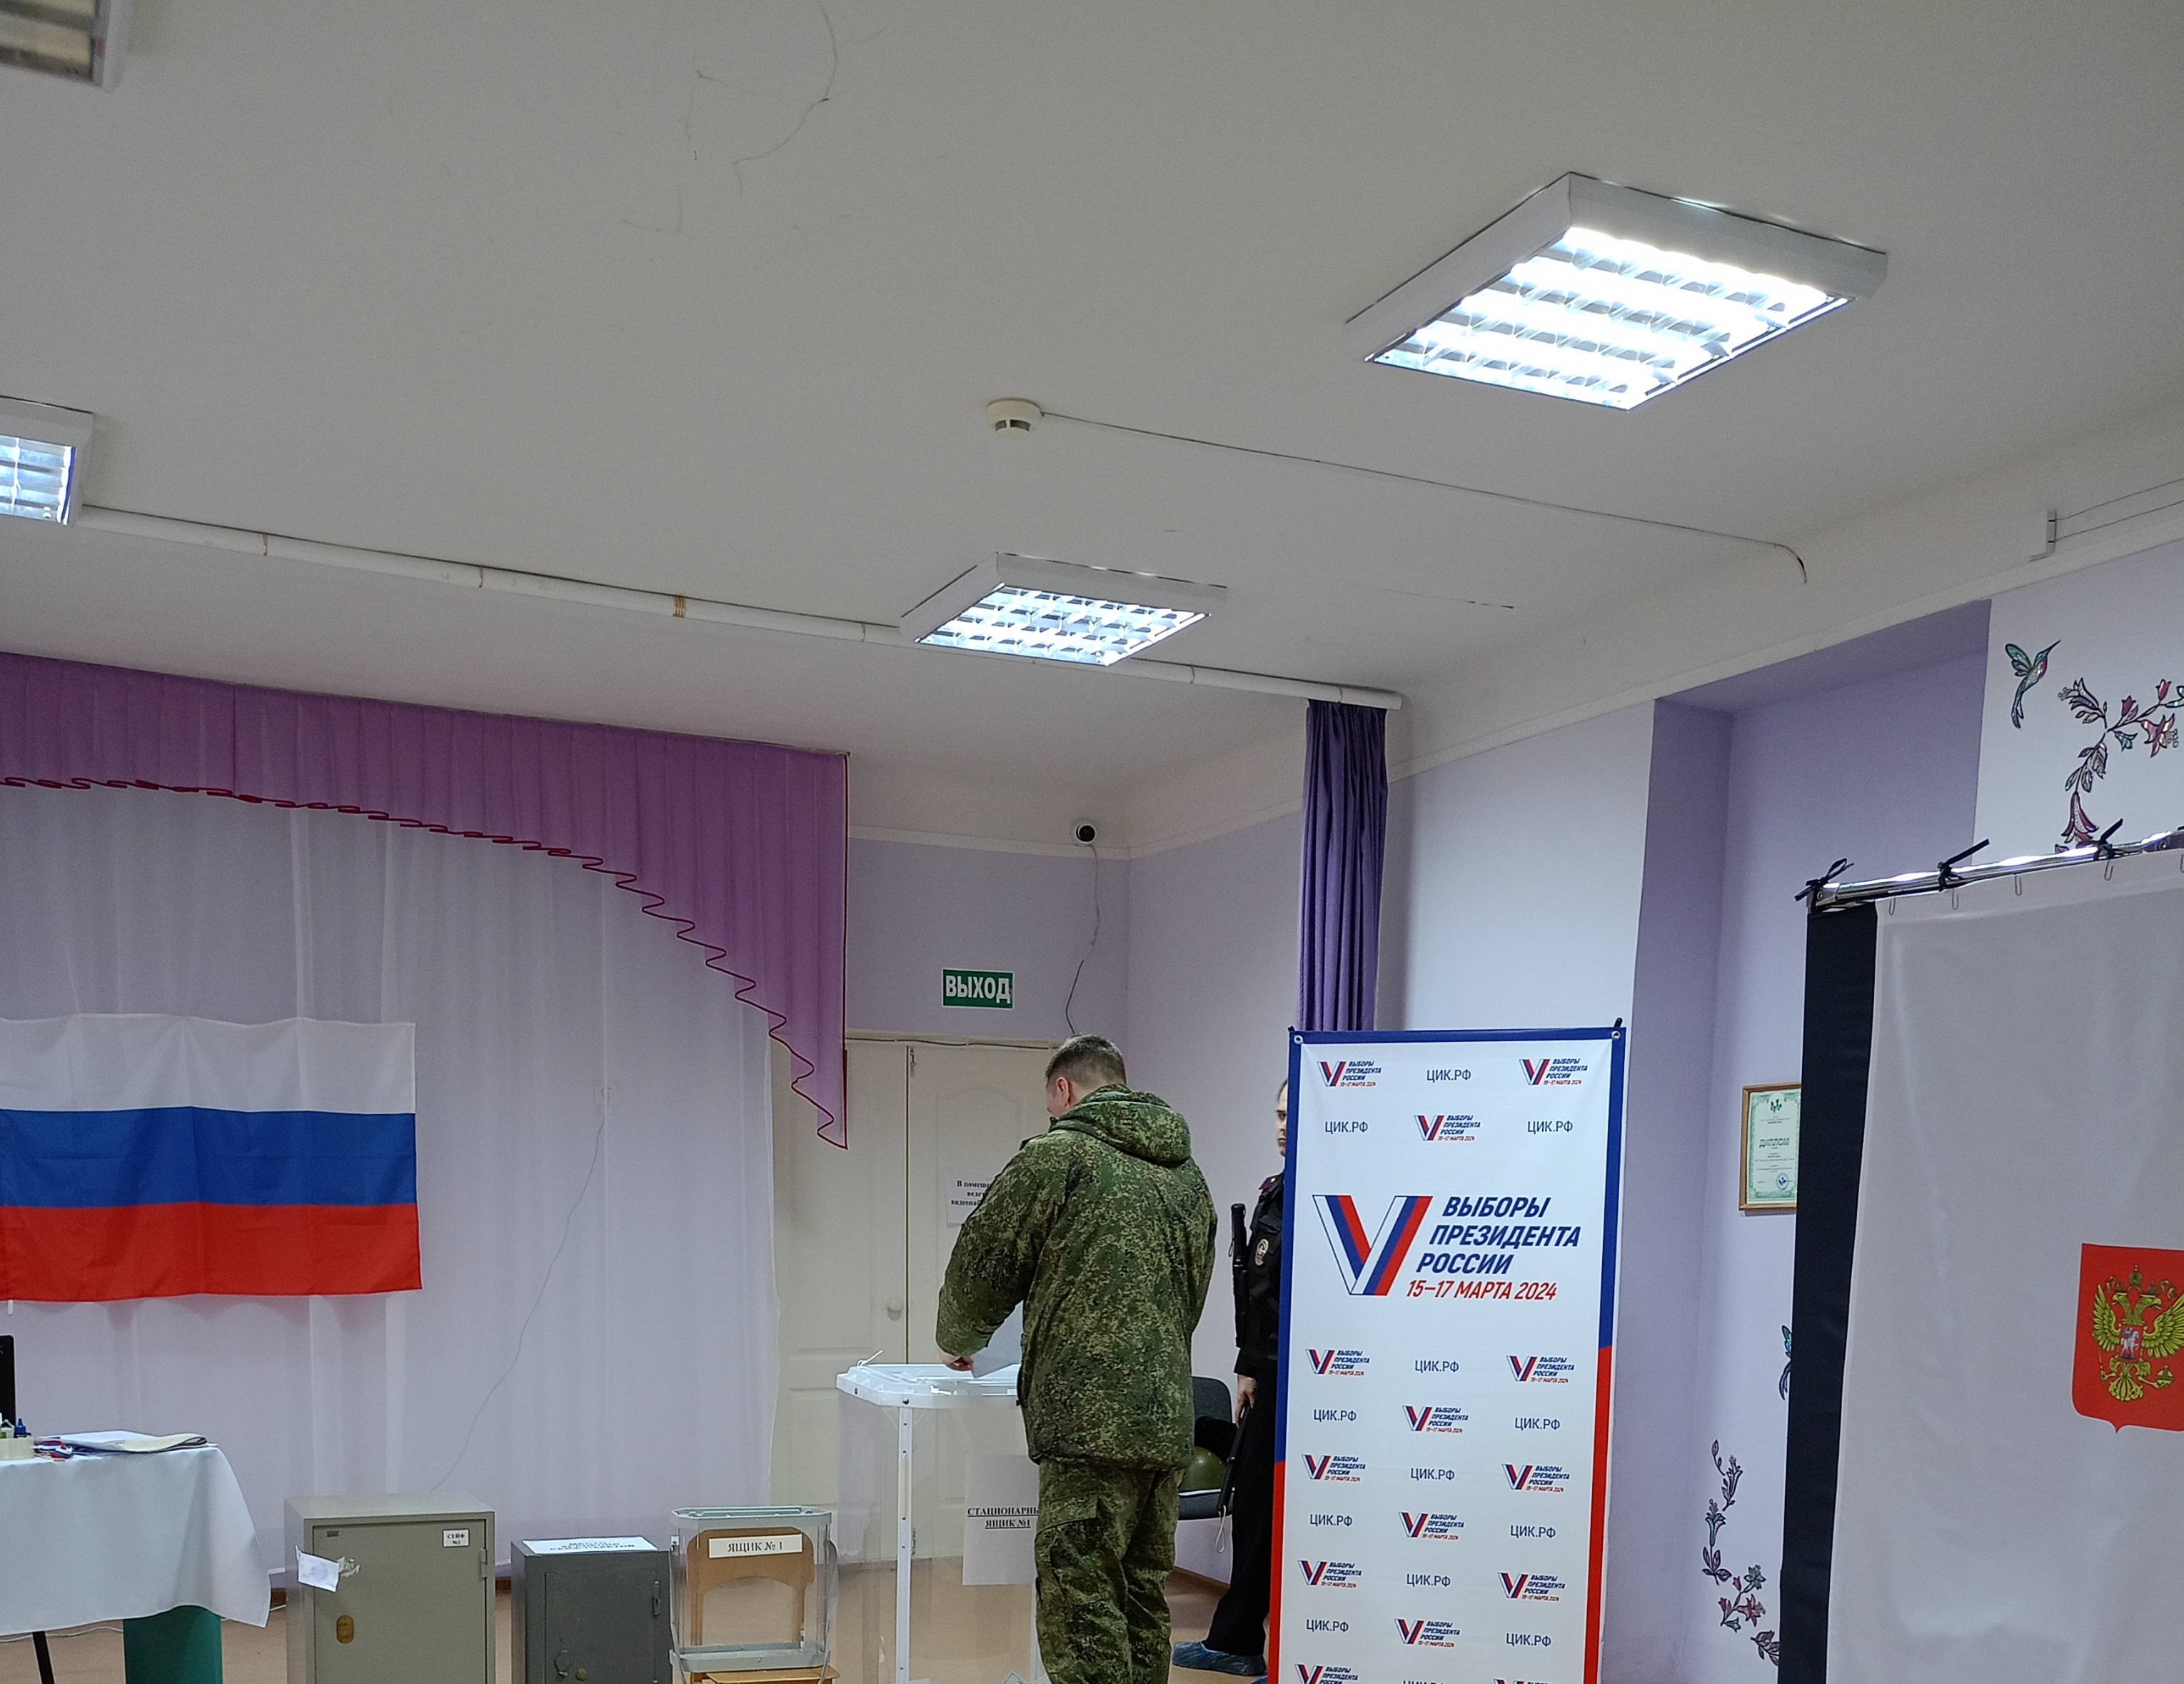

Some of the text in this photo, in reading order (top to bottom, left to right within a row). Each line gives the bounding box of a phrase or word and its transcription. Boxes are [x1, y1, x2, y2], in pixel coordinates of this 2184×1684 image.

[946, 975, 1011, 1004] ВЫХОД
[1427, 1069, 1471, 1083] ЦИК.РФ
[1325, 1121, 1368, 1134] ЦИК.РФ
[1528, 1121, 1573, 1134] ЦИК.РФ
[1441, 1196, 1552, 1218] ВЫБОРЫ
[1428, 1224, 1581, 1250] ПРЕЗИДЕНТА
[1415, 1252, 1515, 1275] РОССИИ
[1453, 1280, 1513, 1300] МАРТА
[1513, 1282, 1558, 1300] 2024
[1415, 1360, 1459, 1373] ЦИК.РФ
[1314, 1410, 1357, 1422] ЦИК.РФ
[1515, 1418, 1560, 1430] ЦИК.РФ
[1411, 1468, 1454, 1480] ЦИК.РФ
[985, 1519, 1016, 1528] ЯЩИК
[1310, 1514, 1352, 1527] ЦИК.РФ
[1511, 1525, 1556, 1538] ЦИК.РФ
[728, 1541, 782, 1553] ЯЩИК № 1
[1407, 1574, 1450, 1587] ЦИК.РФ
[1307, 1620, 1349, 1632] ЦИК.РФ
[1422, 1627, 1461, 1635] ПРЕЗИДЕНТА
[1506, 1633, 1551, 1647] ЦИК.РФ
[1322, 1673, 1359, 1681] ПРЕЗИДЕНТА
